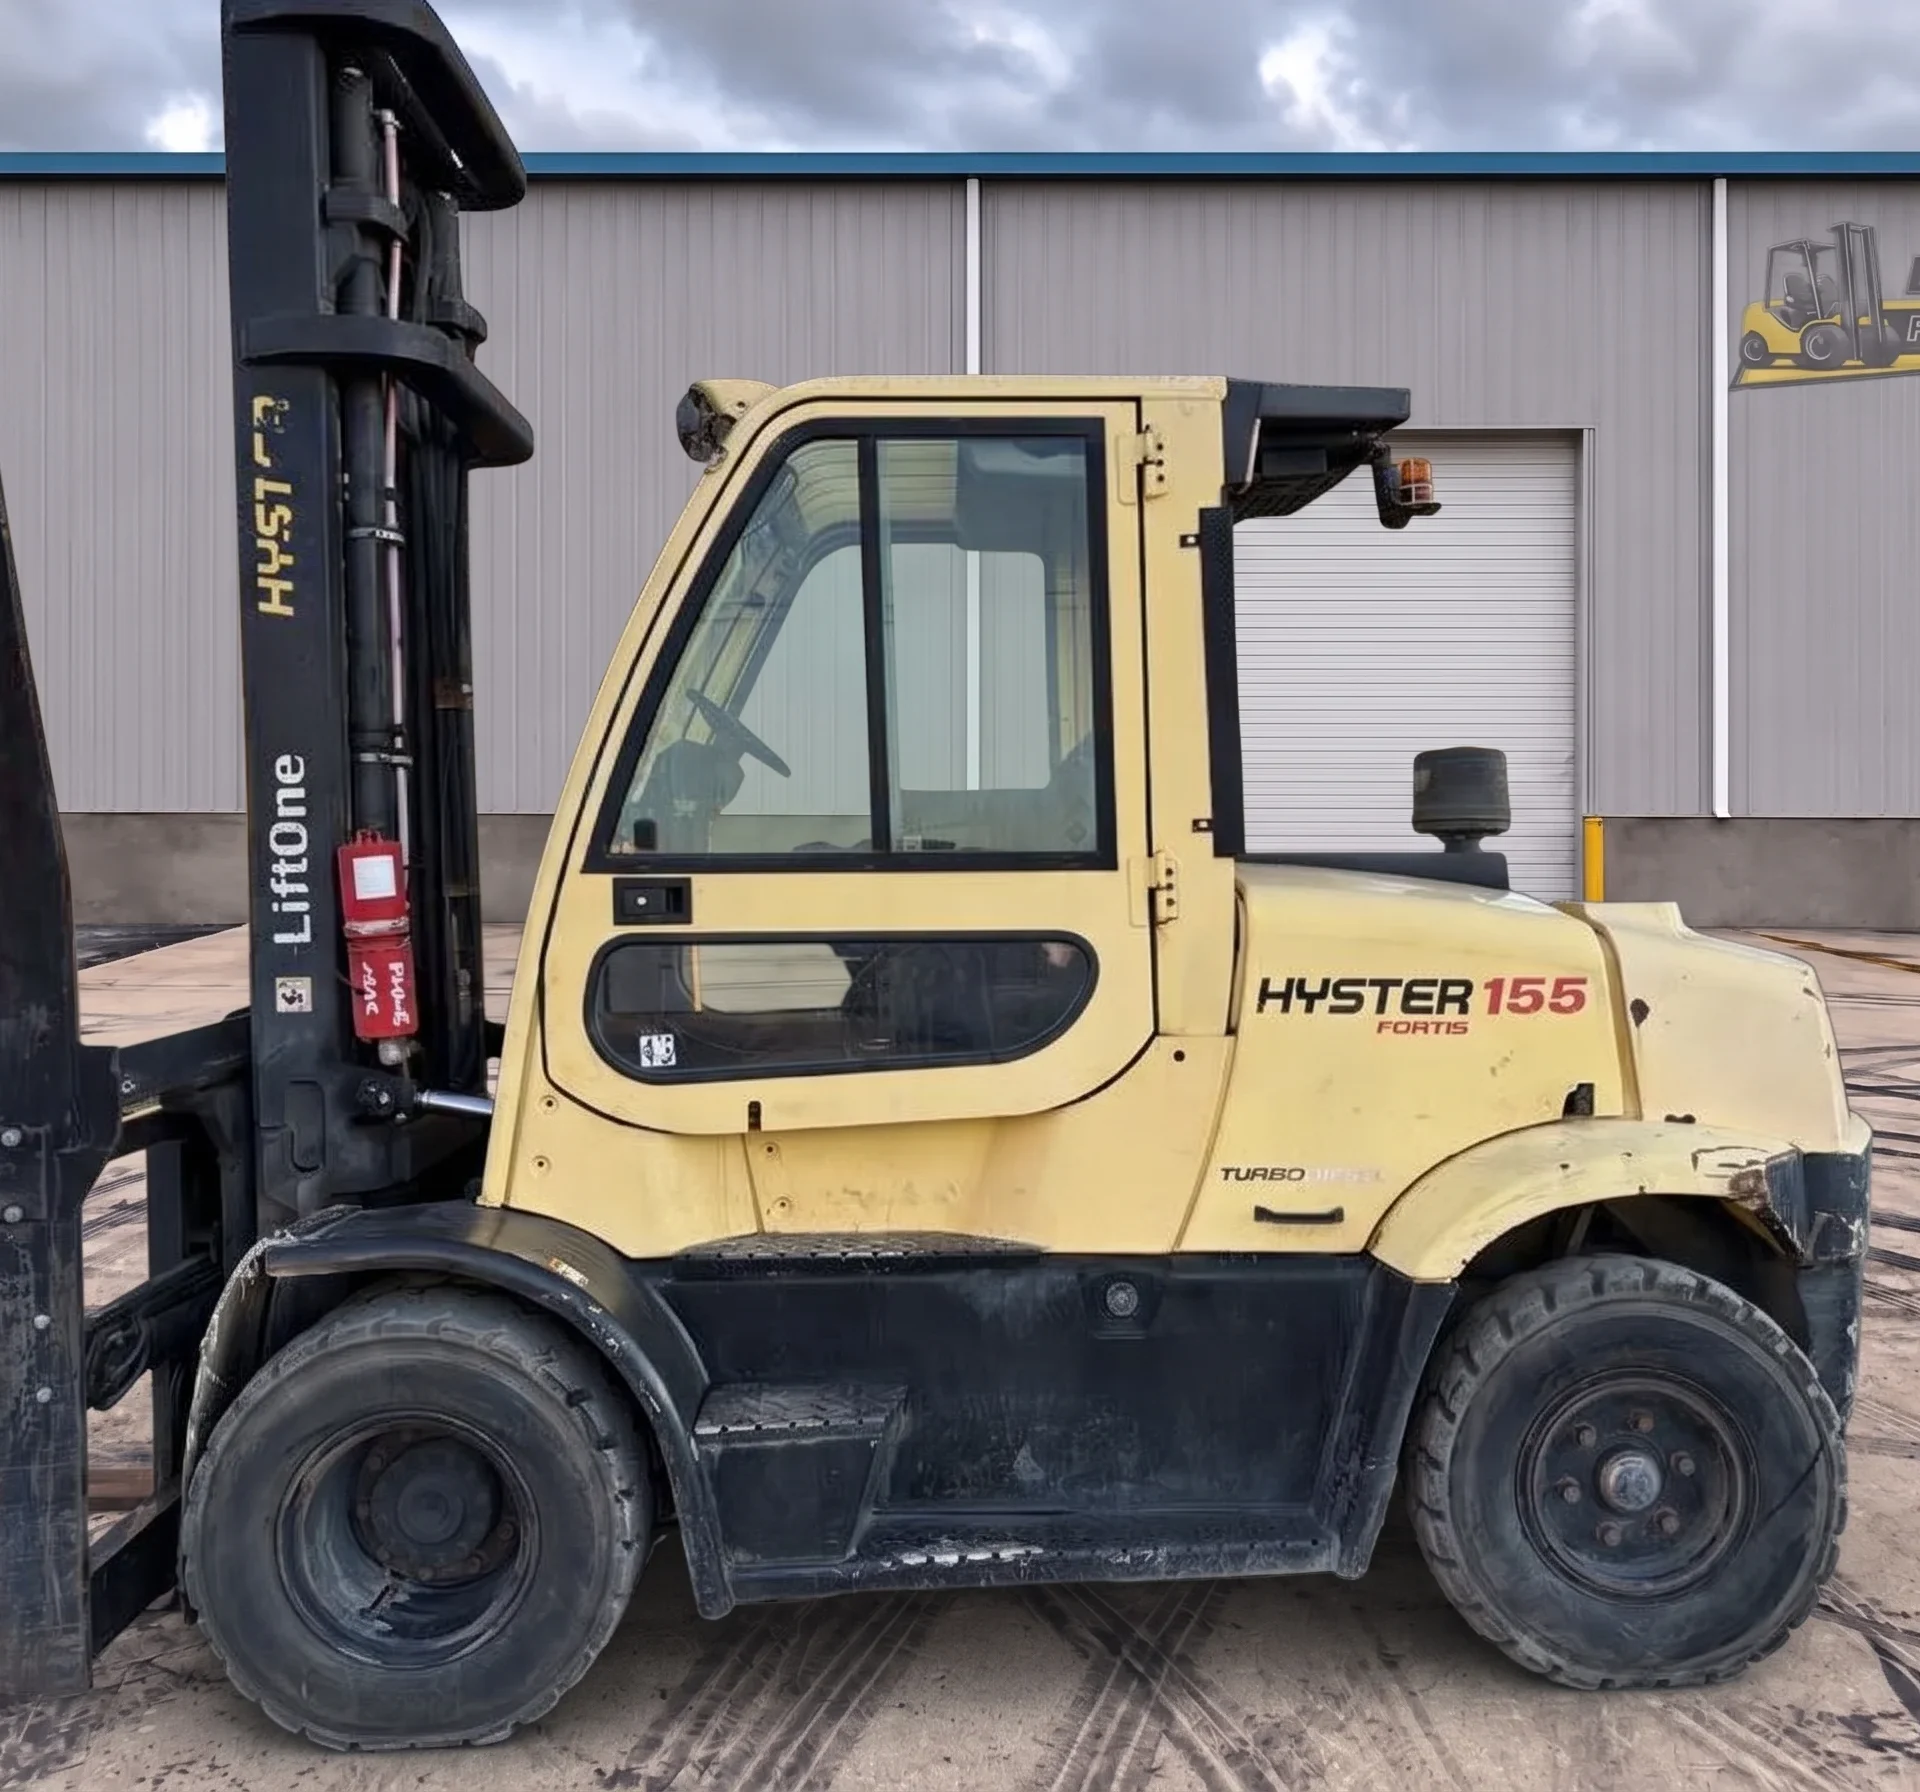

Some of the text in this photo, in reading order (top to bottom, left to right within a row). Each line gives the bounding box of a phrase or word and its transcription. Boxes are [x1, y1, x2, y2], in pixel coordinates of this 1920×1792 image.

[268, 753, 312, 944] LiftOne
[1255, 976, 1589, 1016] HYSTER 155
[1376, 1020, 1470, 1036] FORTIS
